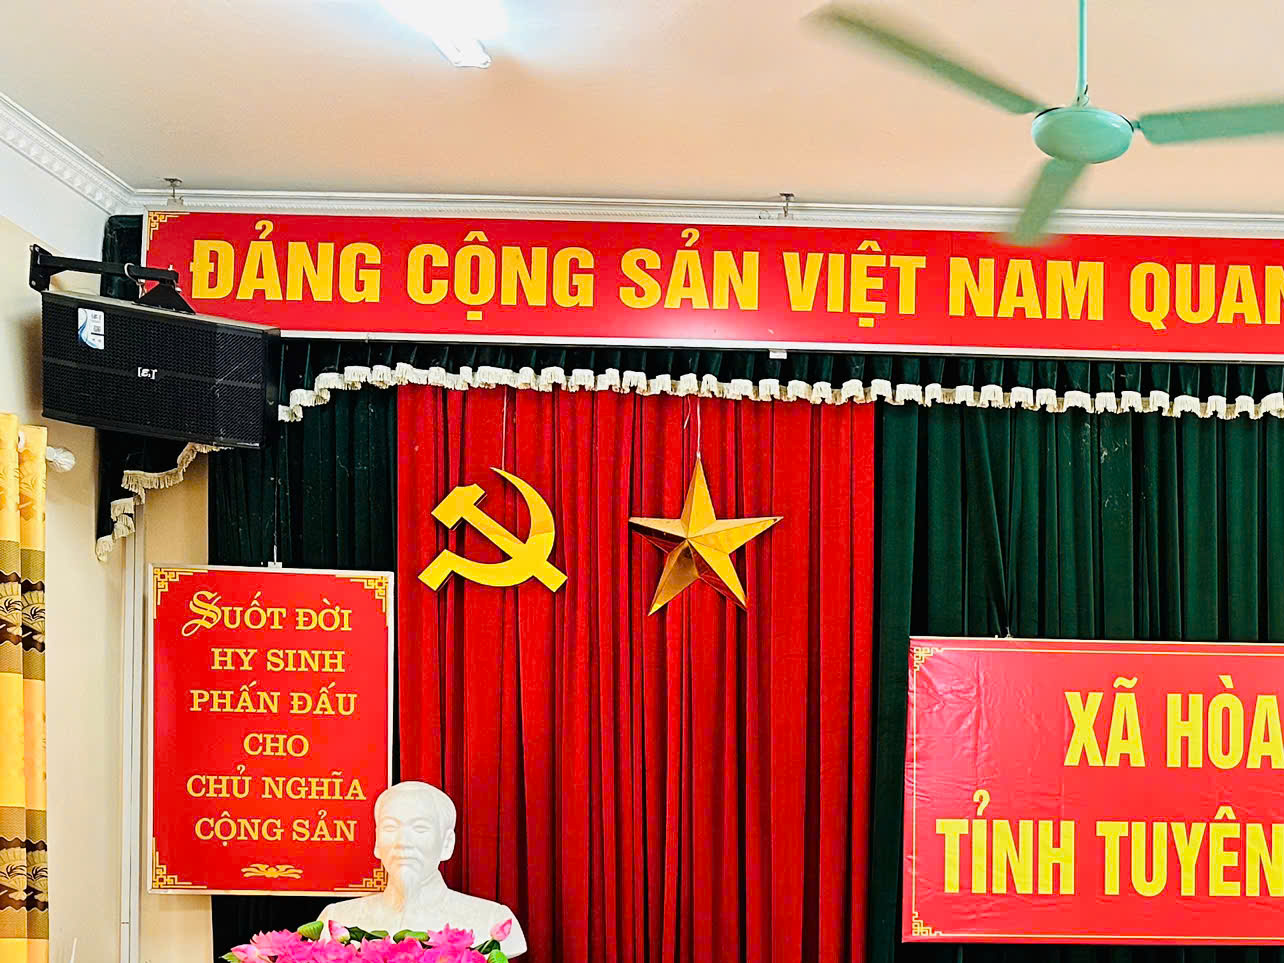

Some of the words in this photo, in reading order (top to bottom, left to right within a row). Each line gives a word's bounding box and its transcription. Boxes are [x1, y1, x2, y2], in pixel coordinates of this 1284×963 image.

[189, 219, 381, 303] ĐẢNG
[407, 231, 595, 321] CỘNG
[619, 227, 760, 311] SẢN
[783, 239, 927, 328] VIỆT
[948, 256, 1105, 321] NAM
[181, 590, 287, 638] SUỐT
[295, 599, 353, 632] ĐỜI
[211, 647, 257, 671] HY
[266, 648, 345, 673] SINH
[191, 680, 281, 713] PHẤN
[289, 681, 358, 716] ĐẤU
[1063, 676, 1146, 768] XÃ
[243, 733, 310, 757] CHO
[186, 764, 253, 799] CHỦ
[261, 770, 367, 801] NGHĨA
[195, 810, 285, 847] CỘNG
[292, 809, 358, 841] SẢN
[935, 788, 1075, 895] TỈNH
